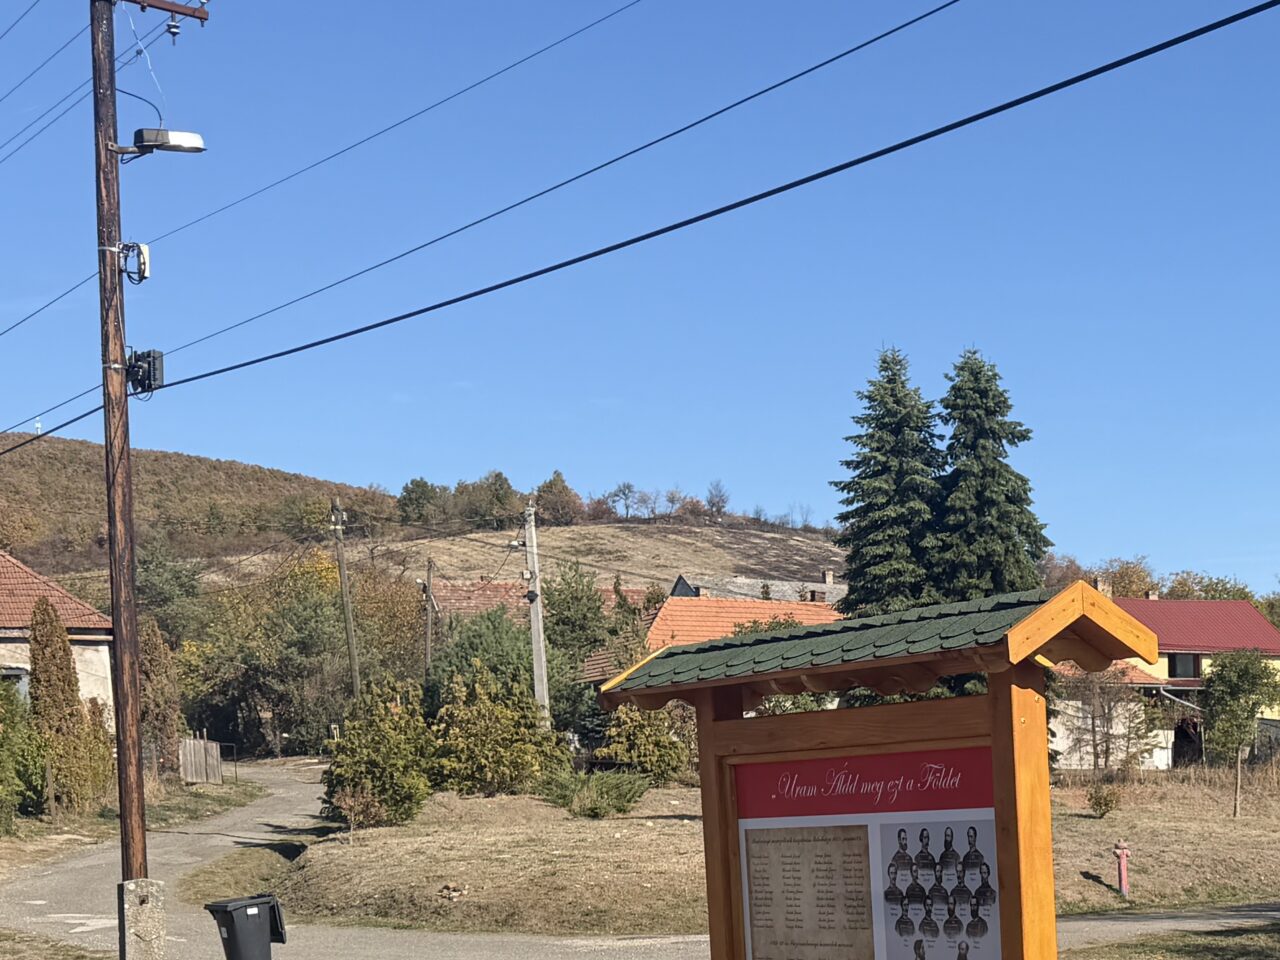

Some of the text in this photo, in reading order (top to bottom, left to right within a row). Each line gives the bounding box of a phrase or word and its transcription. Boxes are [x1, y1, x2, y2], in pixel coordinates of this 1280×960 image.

[821, 761, 859, 797] Áldd
[860, 781, 884, 805] meg
[886, 775, 904, 804] ezt
[906, 781, 914, 791] a
[918, 763, 962, 791] Földet
